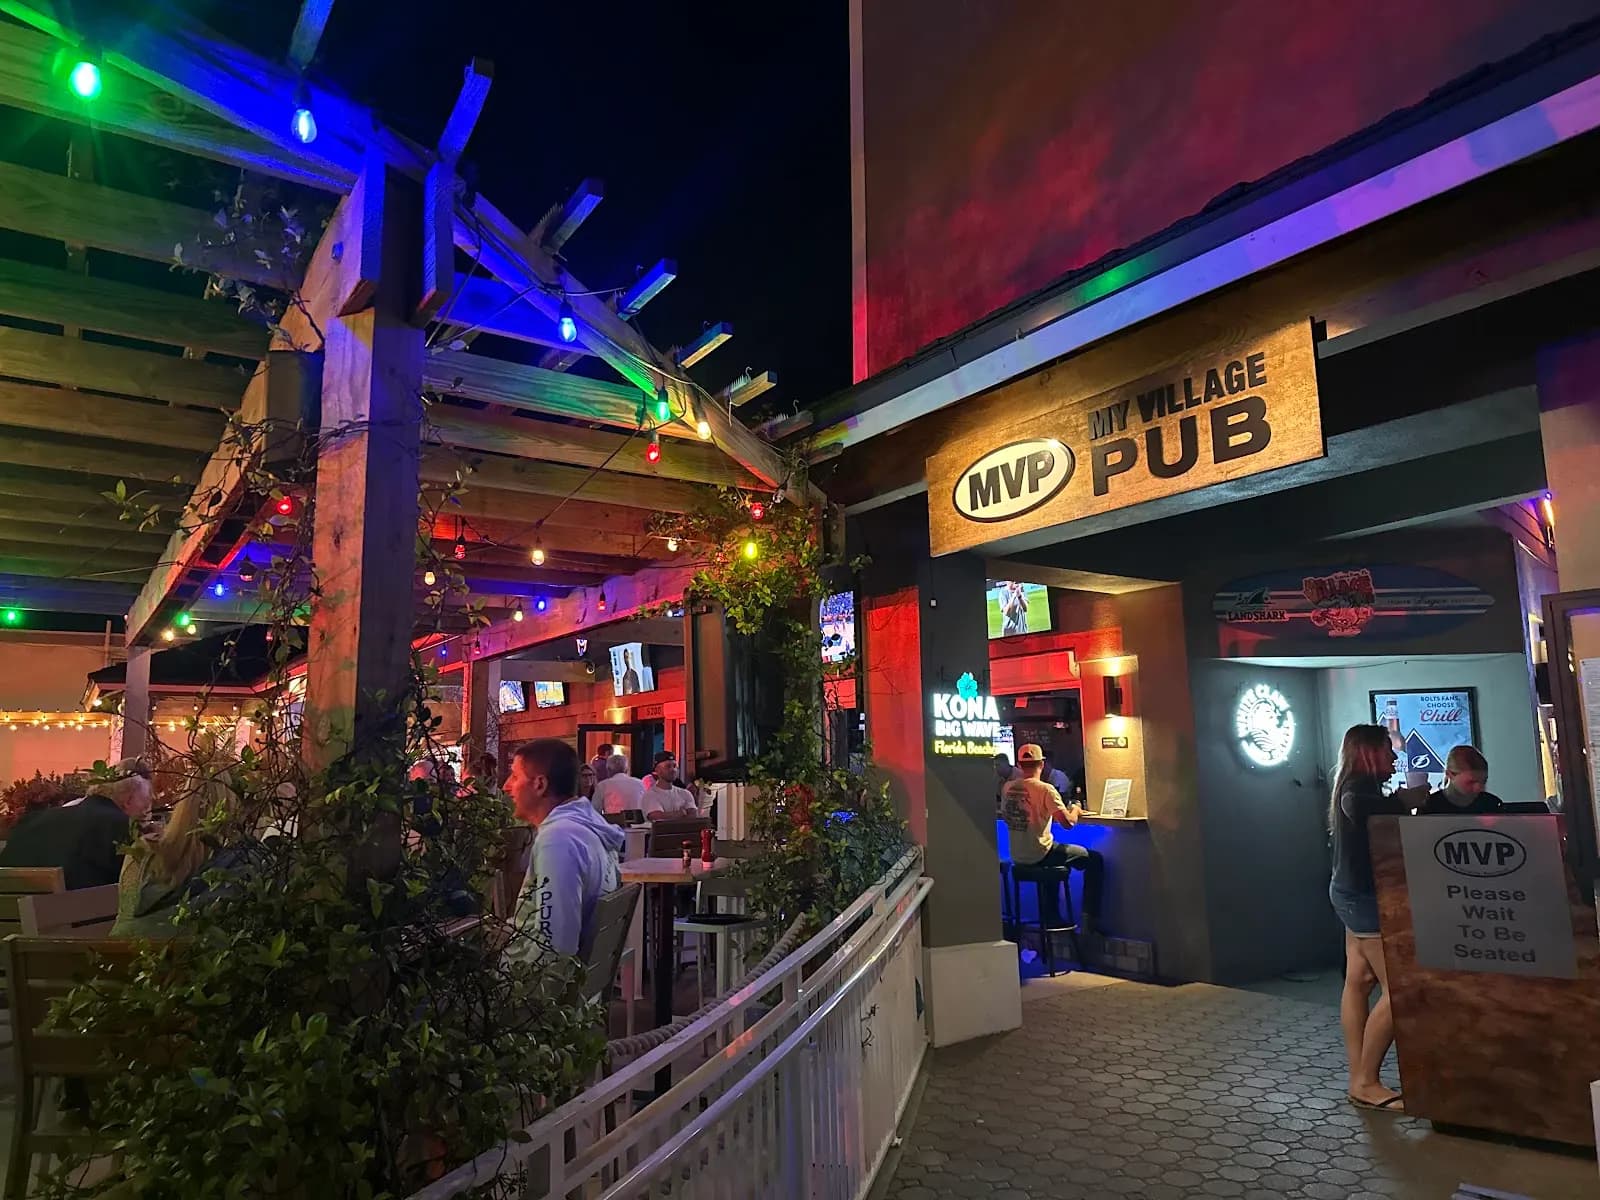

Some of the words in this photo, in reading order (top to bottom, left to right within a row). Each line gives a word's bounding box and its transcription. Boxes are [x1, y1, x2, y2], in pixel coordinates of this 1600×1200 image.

[1088, 400, 1129, 441] MY
[1136, 352, 1267, 423] VILLAGE
[1093, 396, 1272, 497] PUB
[968, 449, 1056, 511] MVP
[933, 693, 1000, 720] KONA
[1420, 709, 1463, 722] Chill
[935, 720, 961, 737] BIG
[961, 721, 1001, 737] WAVE
[934, 740, 966, 754] Florida
[1444, 842, 1515, 866] MVP
[1447, 885, 1526, 901] Please
[1461, 905, 1517, 921] Wait
[1458, 925, 1486, 940] To
[1494, 927, 1526, 942] Be
[1454, 944, 1536, 963] Seated
